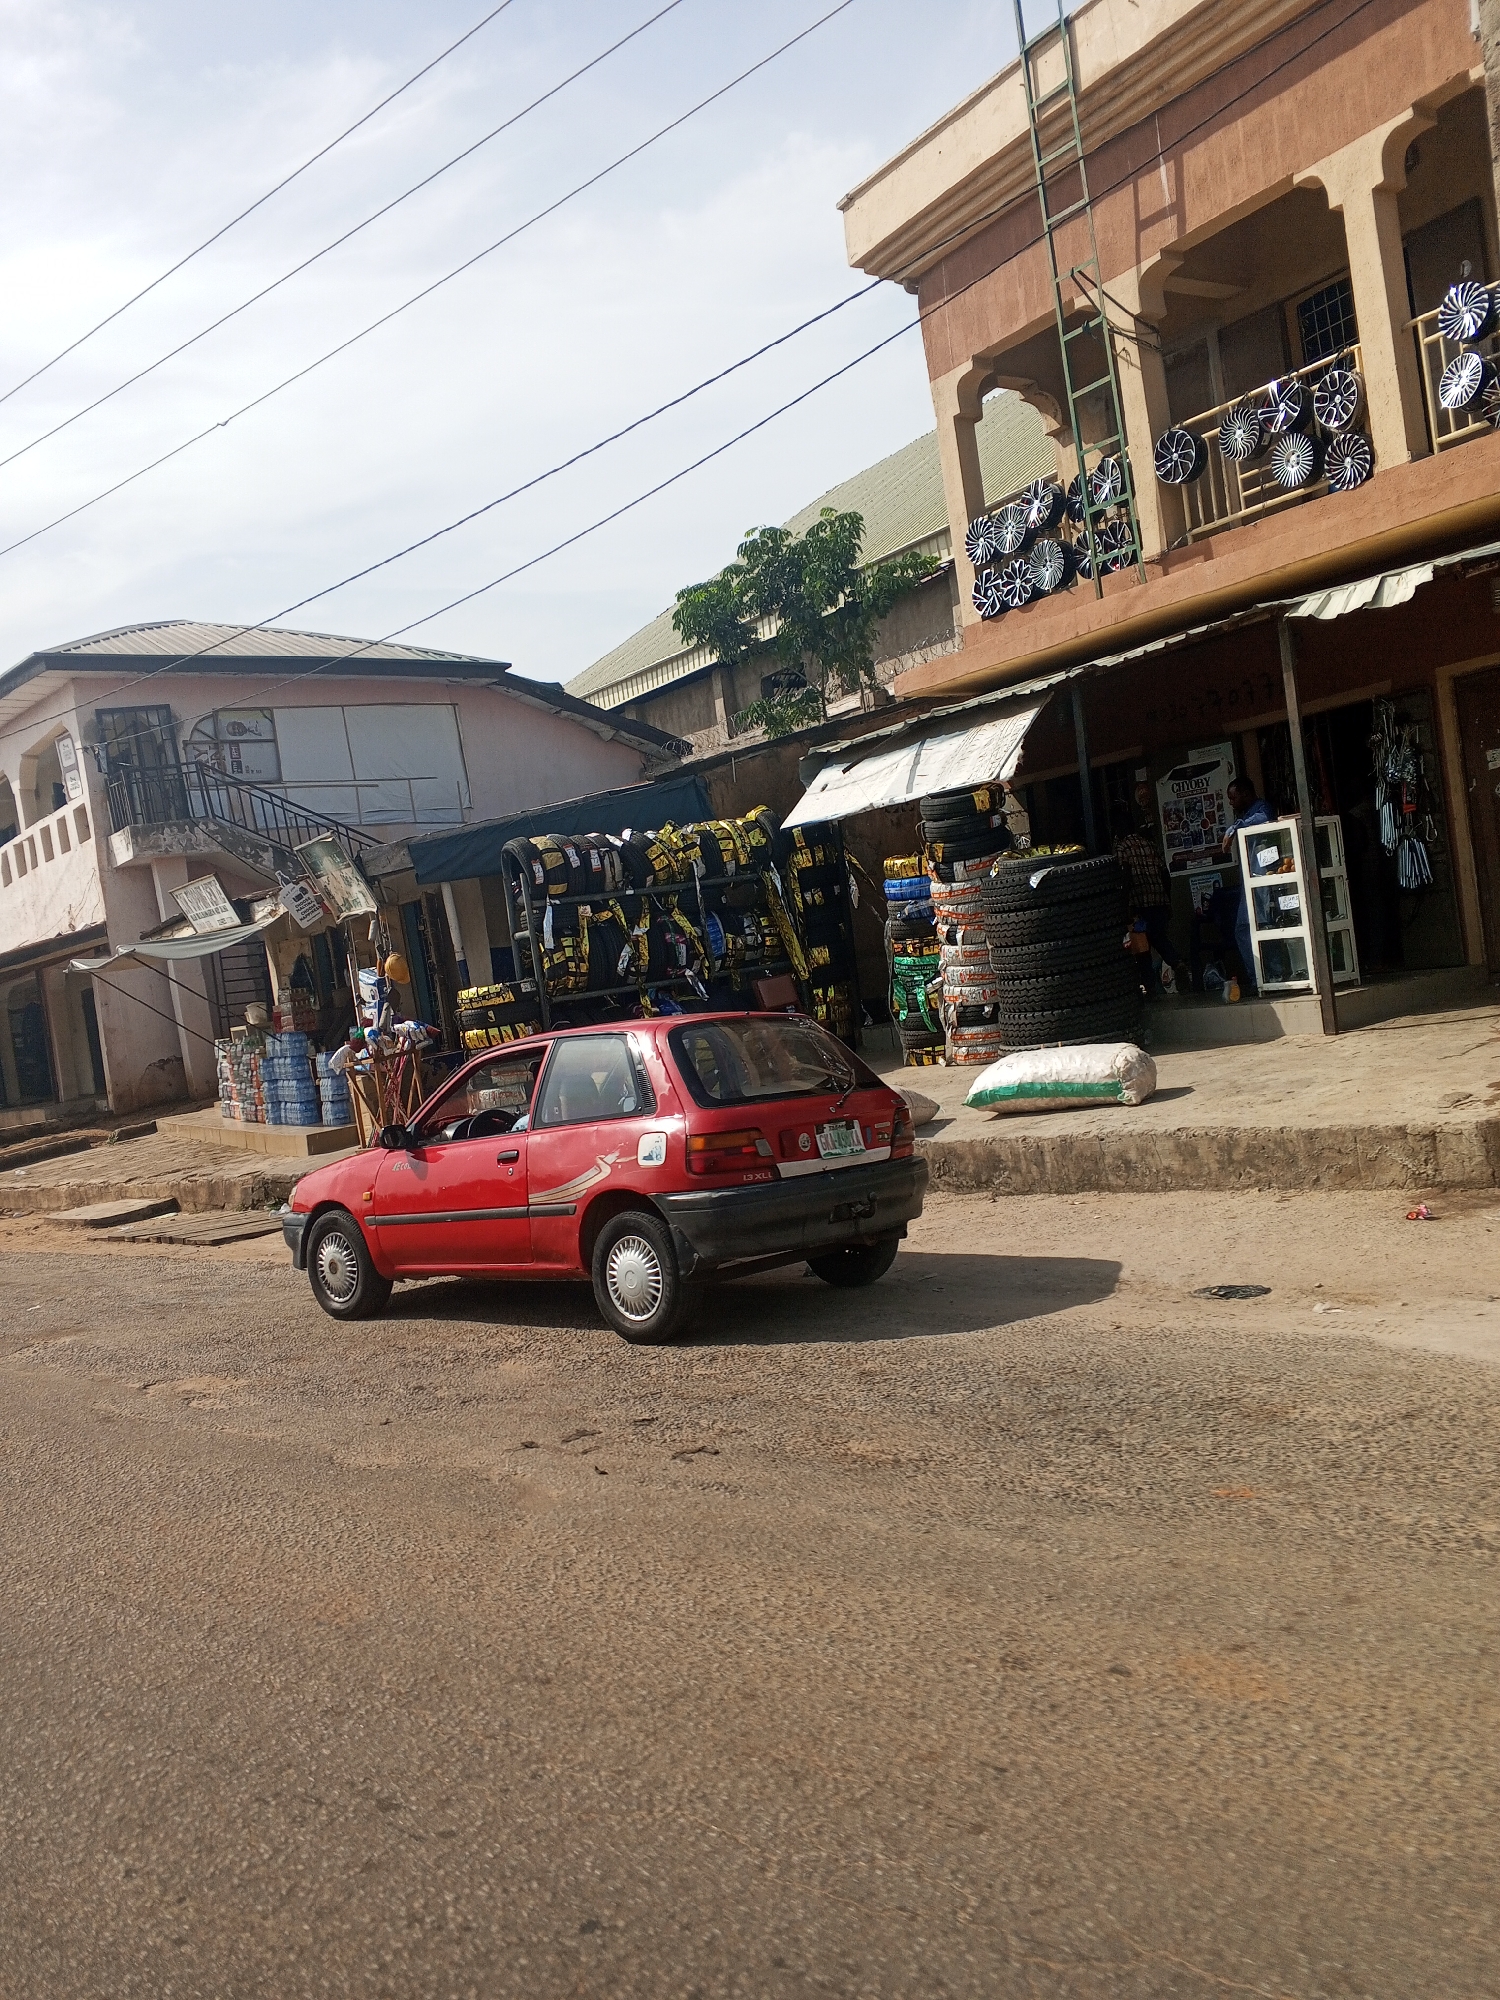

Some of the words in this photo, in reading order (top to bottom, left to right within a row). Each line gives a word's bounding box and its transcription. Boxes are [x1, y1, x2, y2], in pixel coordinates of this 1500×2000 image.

[1171, 776, 1211, 794] CHYOBY
[295, 896, 311, 909] CHOOSE
[300, 904, 316, 916] CHOOSE
